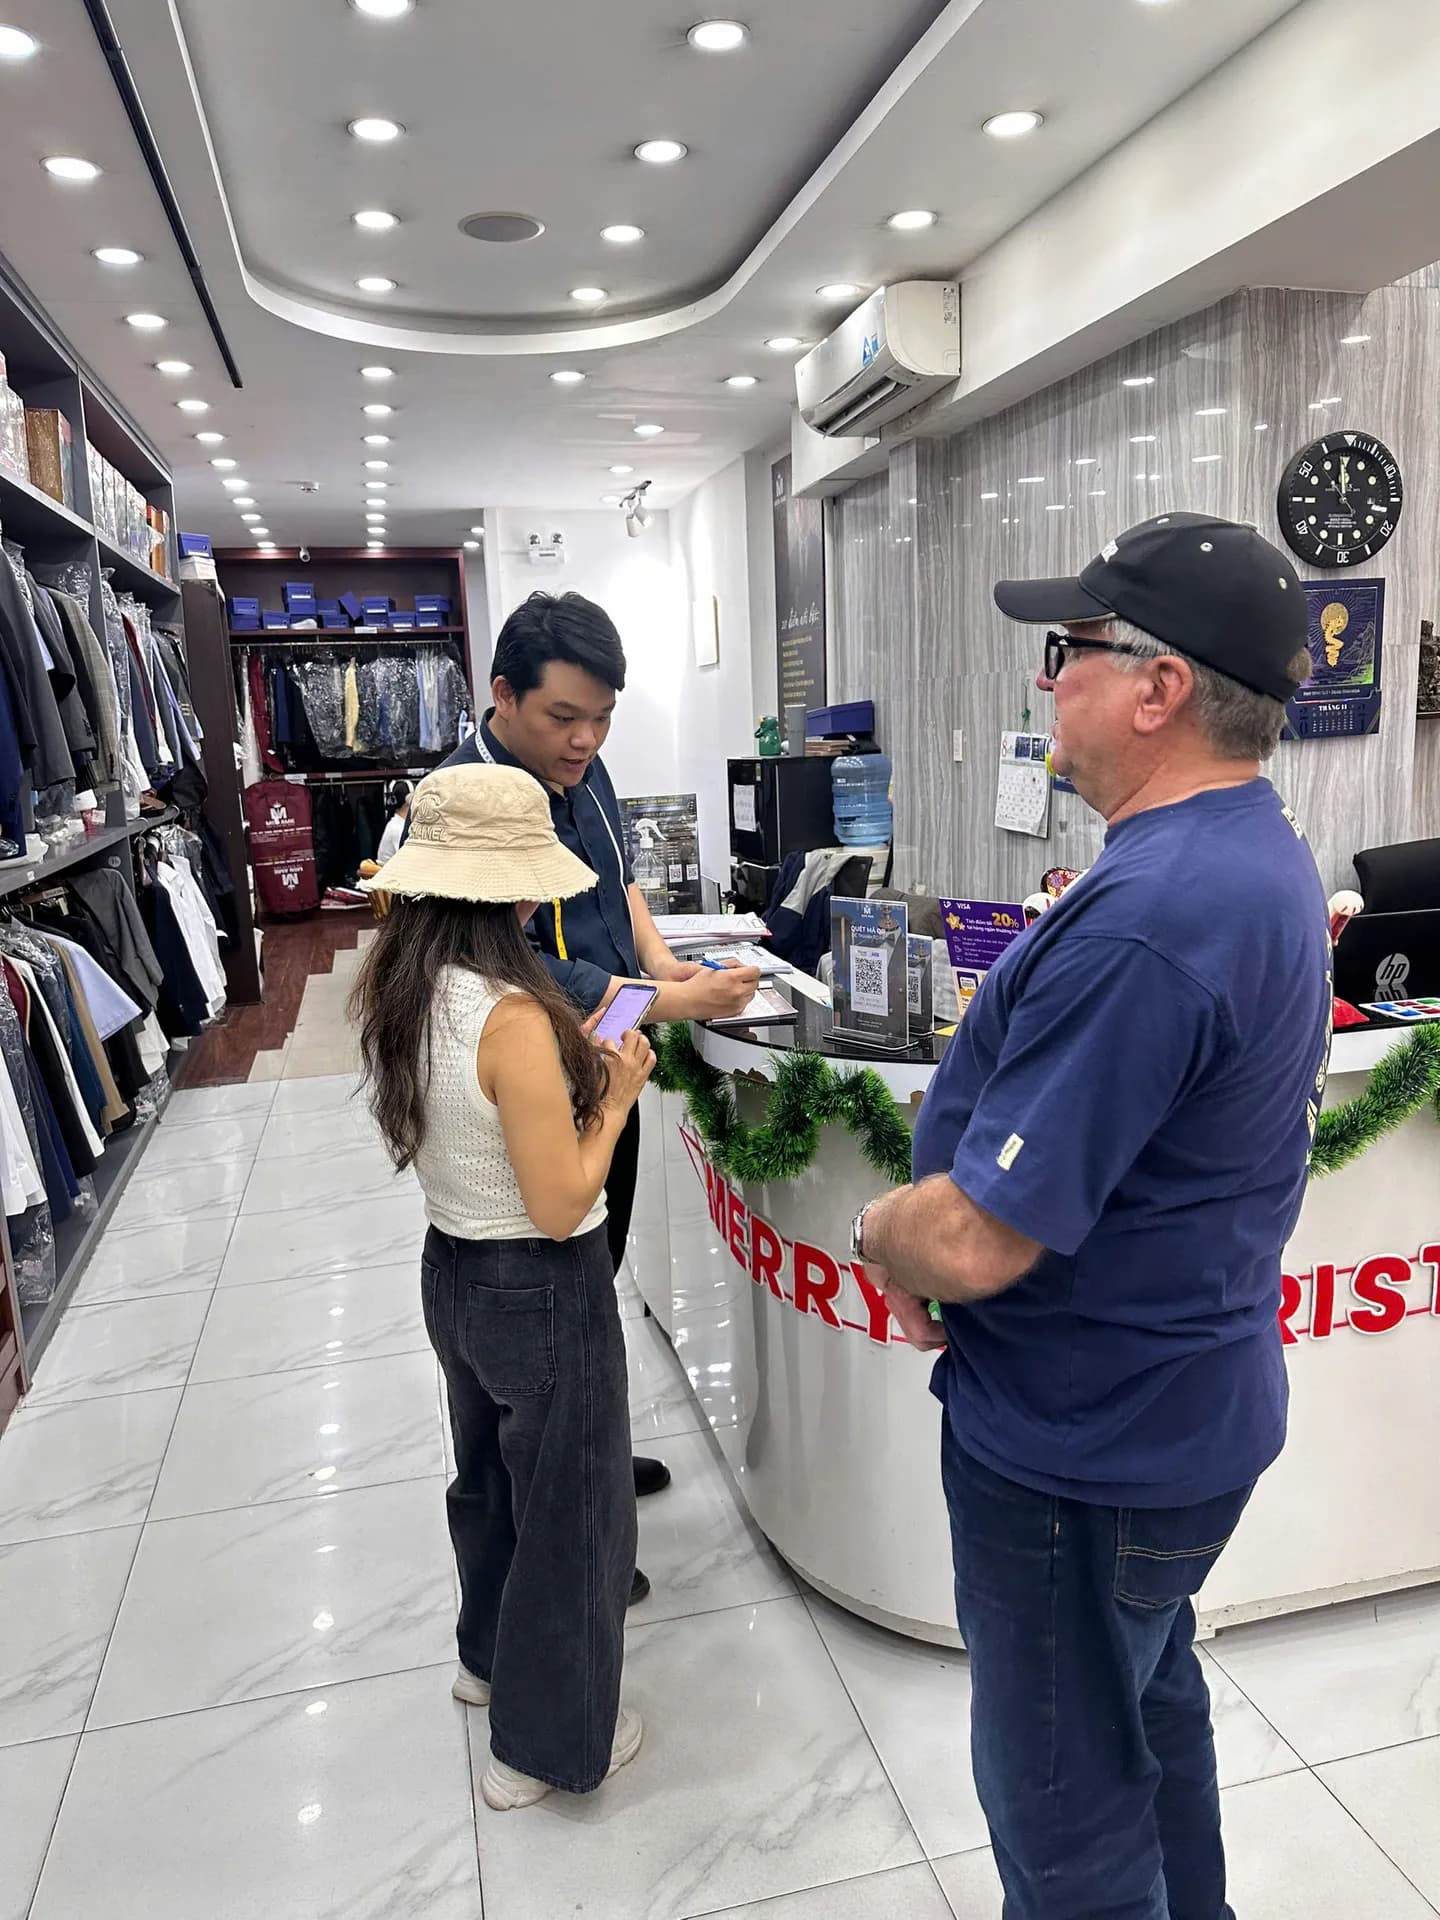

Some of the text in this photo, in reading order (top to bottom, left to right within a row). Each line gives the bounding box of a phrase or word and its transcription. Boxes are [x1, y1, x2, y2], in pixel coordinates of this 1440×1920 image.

[1298, 461, 1313, 478] 50
[1295, 520, 1309, 535] 40
[1379, 520, 1393, 536] 20
[1336, 551, 1350, 564] 30
[956, 902, 971, 910] VISA
[992, 912, 1020, 929] 20%
[1377, 953, 1408, 985] hp
[703, 1160, 893, 1344] MERRY
